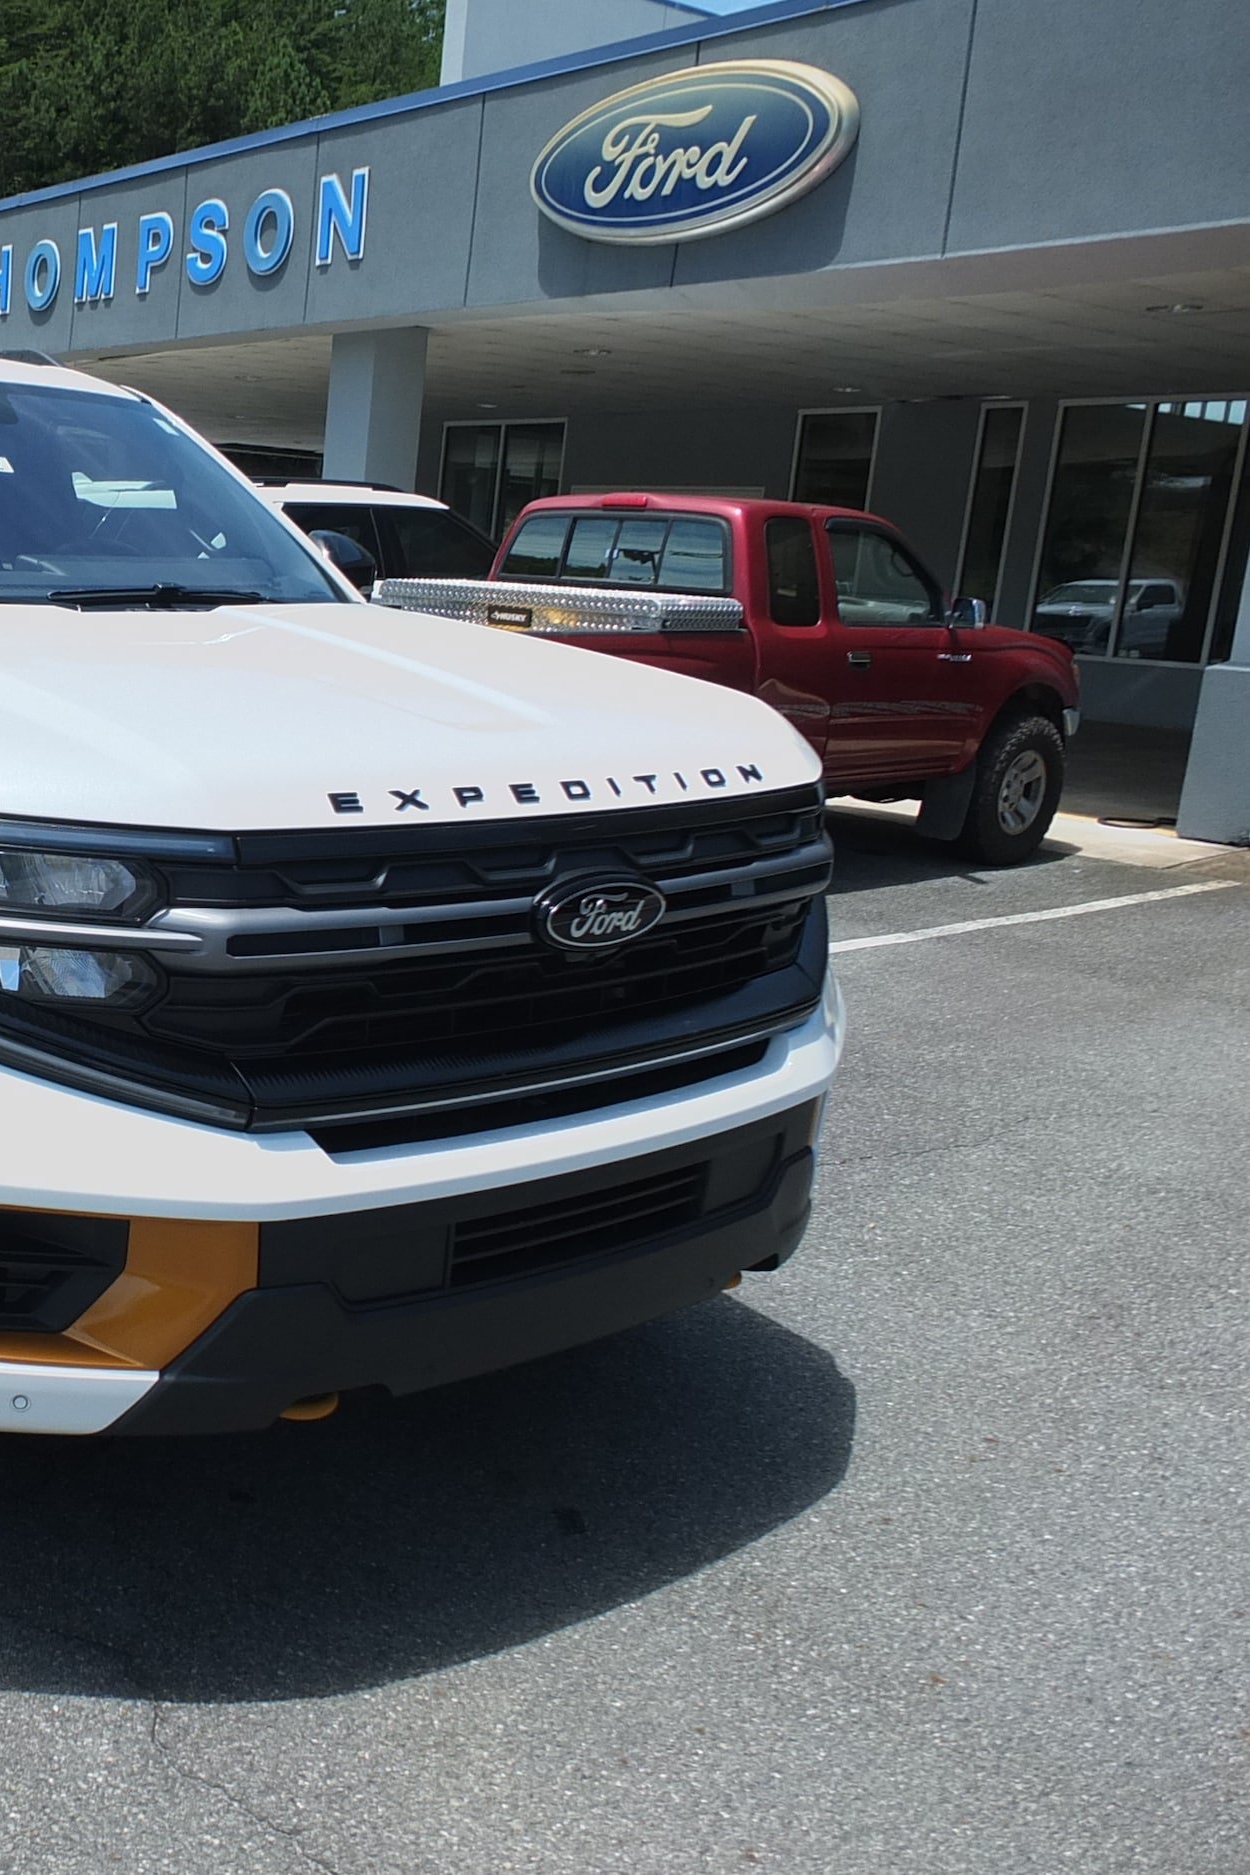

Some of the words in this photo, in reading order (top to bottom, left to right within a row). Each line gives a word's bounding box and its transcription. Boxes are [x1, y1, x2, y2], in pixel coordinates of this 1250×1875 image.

[584, 104, 757, 209] Ford
[328, 764, 764, 814] EXPEDITION
[570, 889, 643, 938] Ford
